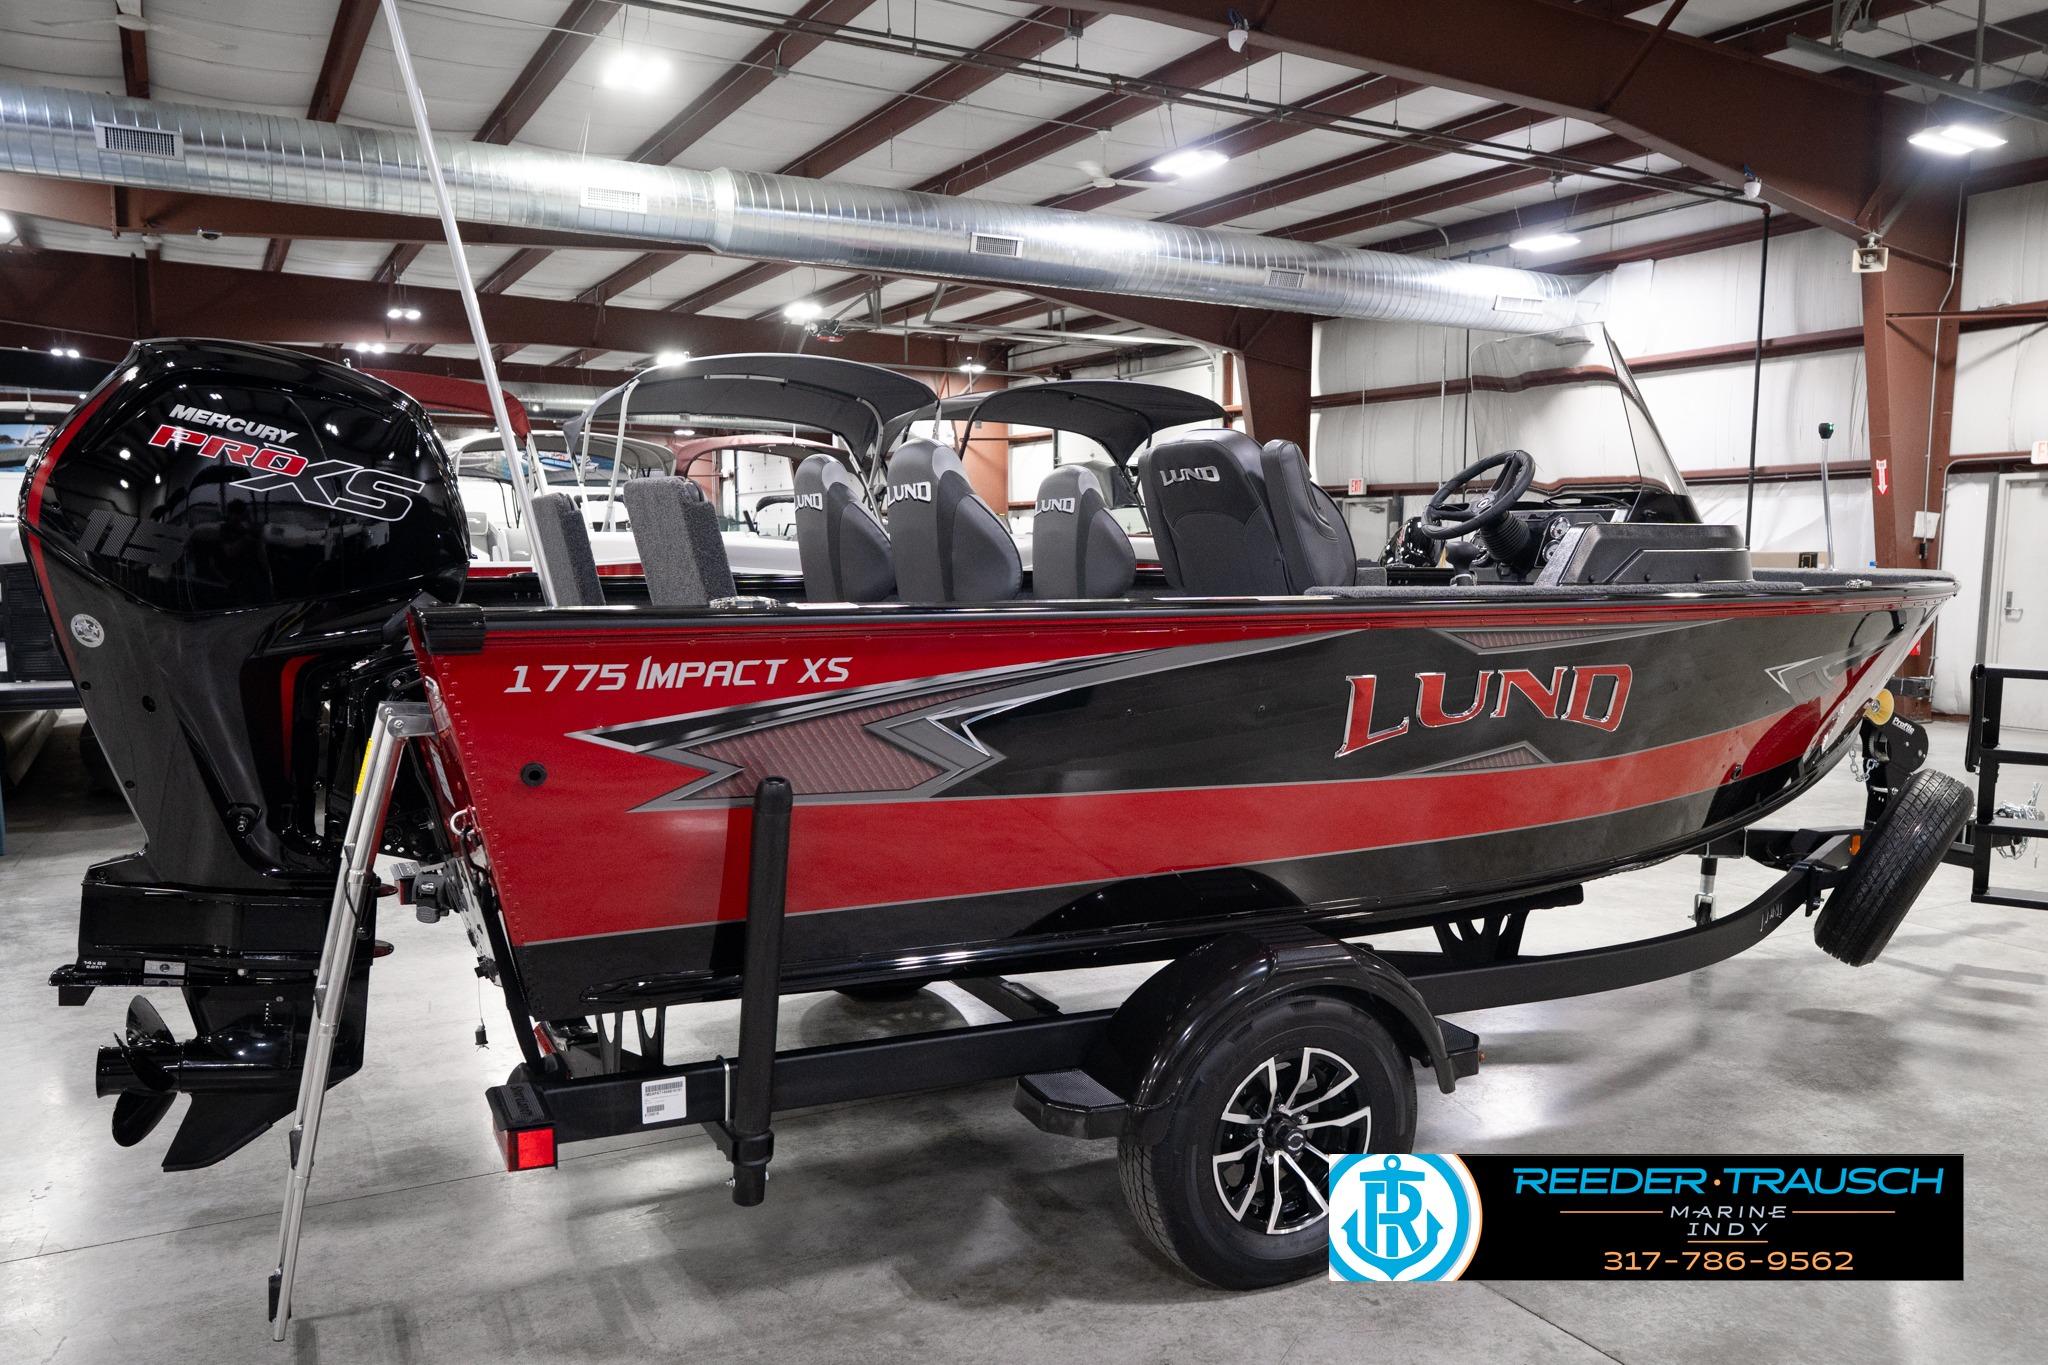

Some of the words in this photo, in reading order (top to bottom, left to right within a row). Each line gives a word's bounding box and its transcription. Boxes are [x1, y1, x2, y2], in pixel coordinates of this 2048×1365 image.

[168, 404, 299, 444] MERCURY
[148, 424, 309, 477] PRO
[229, 459, 426, 521] XS
[1160, 465, 1220, 487] LUND
[793, 492, 823, 511] LUND
[887, 481, 932, 507] LUND
[1034, 497, 1076, 516] LUND
[504, 665, 630, 693] 1775
[636, 656, 789, 691] IMPACT
[797, 656, 853, 684] XS
[1334, 664, 1633, 759] LUND
